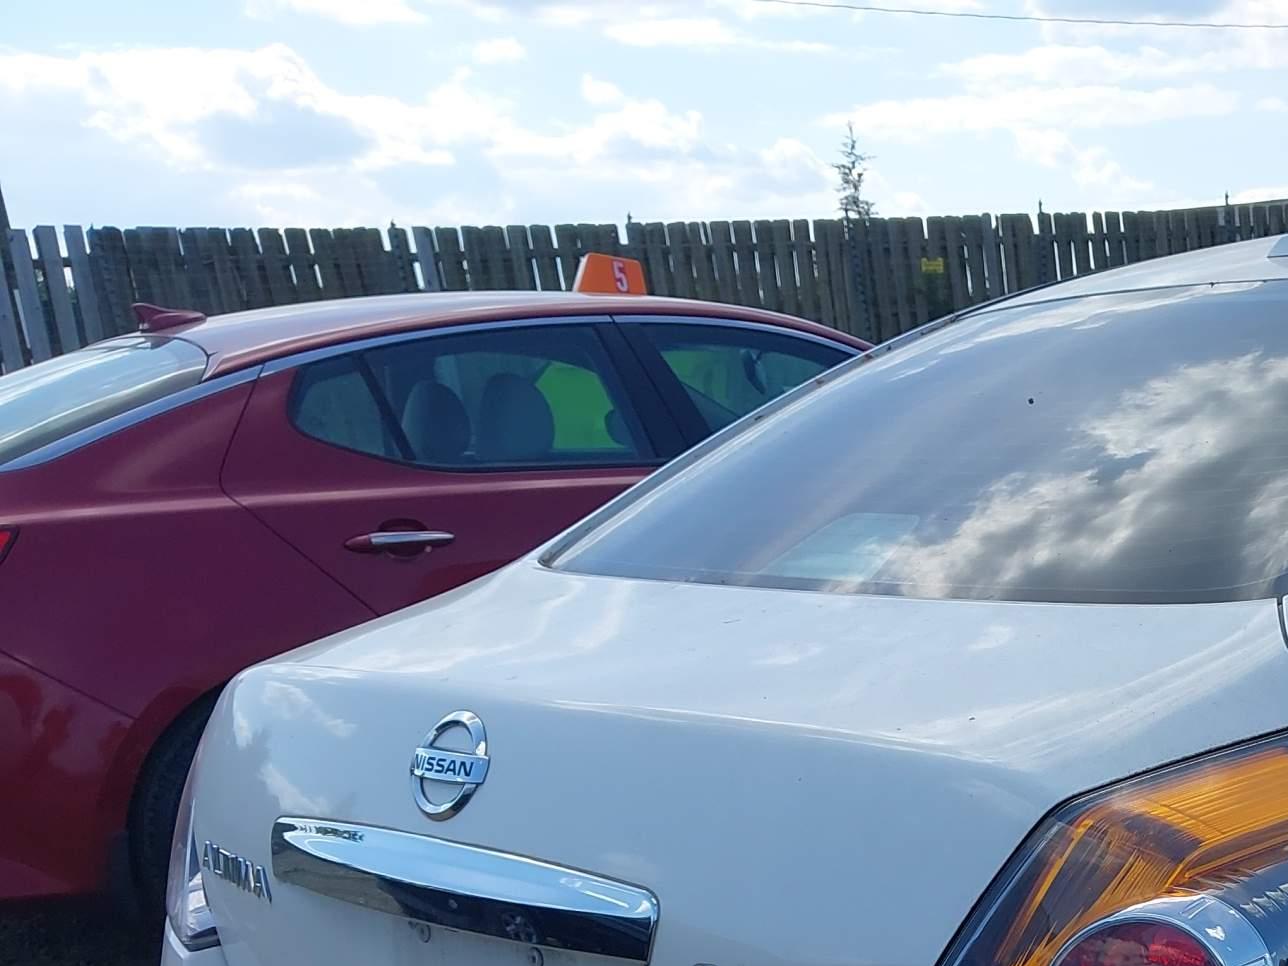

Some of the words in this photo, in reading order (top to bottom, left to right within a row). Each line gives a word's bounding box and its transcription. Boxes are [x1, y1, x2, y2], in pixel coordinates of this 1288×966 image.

[613, 260, 629, 292] 5
[415, 753, 474, 777] NISSAN
[203, 840, 272, 904] ALTIMA
